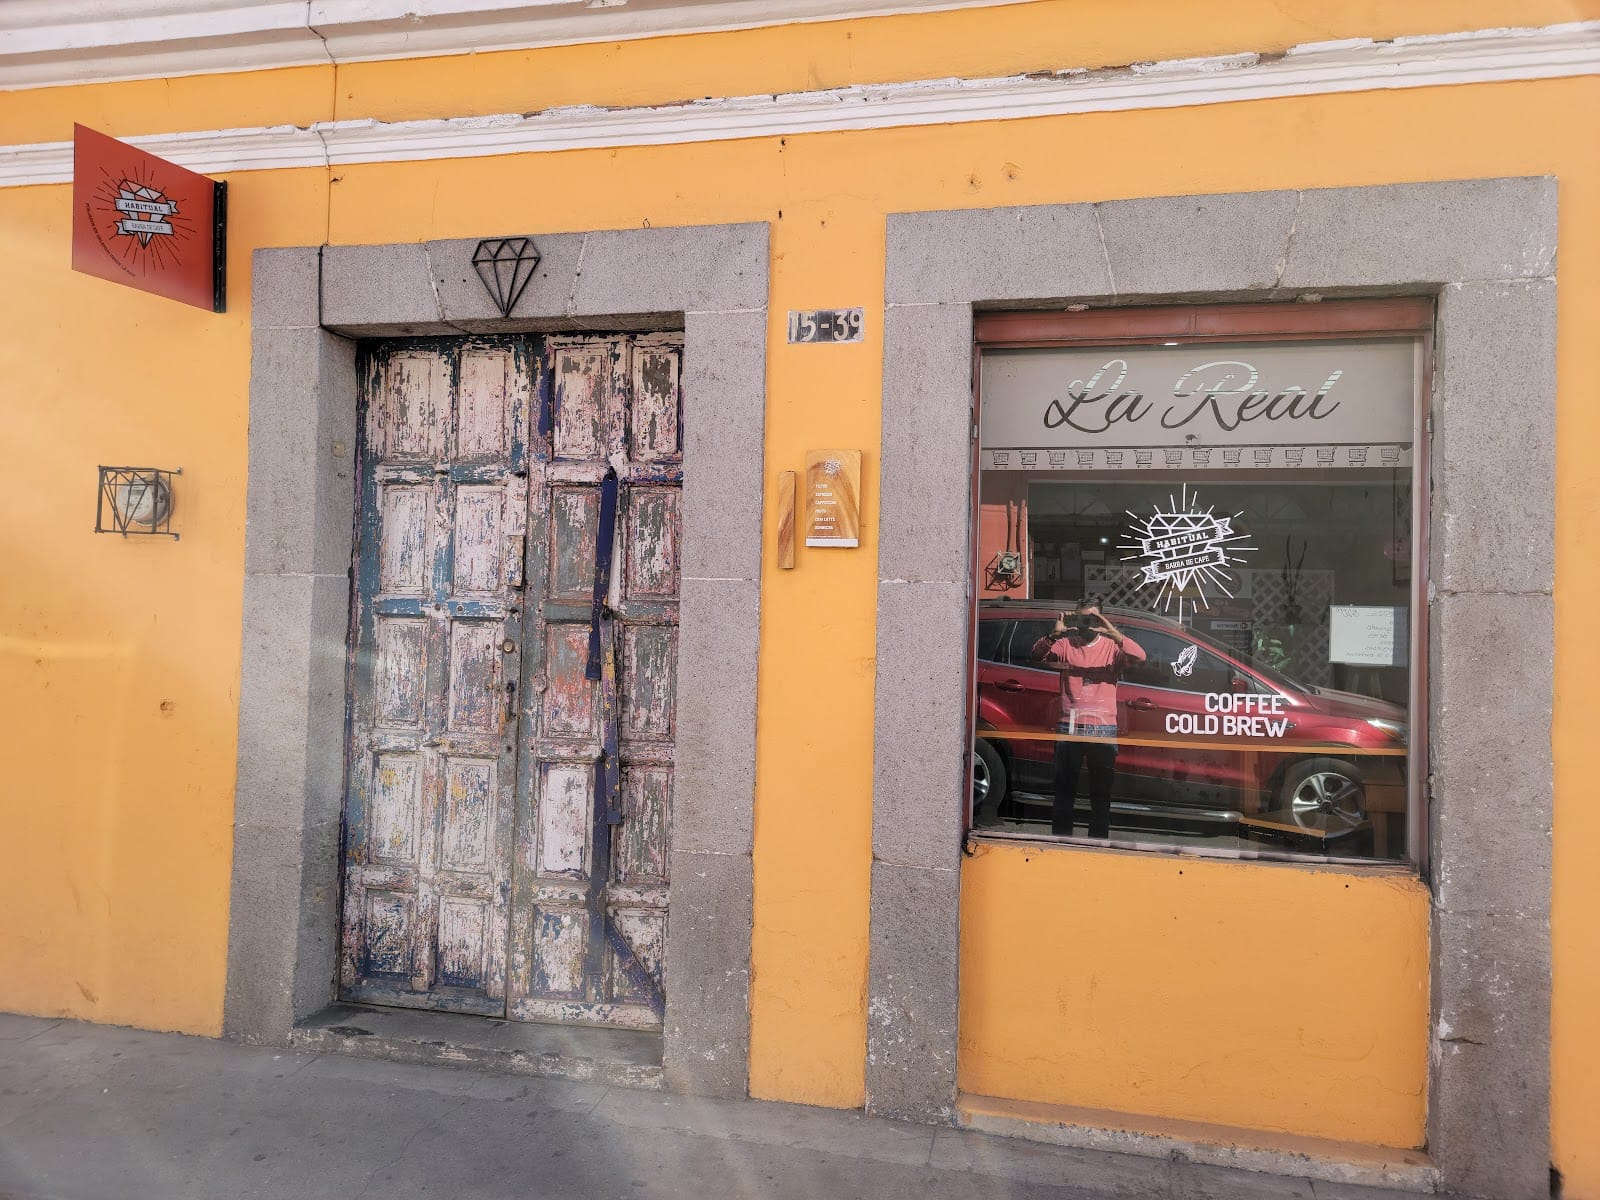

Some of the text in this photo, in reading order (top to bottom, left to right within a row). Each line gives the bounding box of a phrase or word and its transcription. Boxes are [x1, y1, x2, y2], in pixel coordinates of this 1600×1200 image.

[124, 202, 163, 212] HABITUAL
[789, 310, 864, 342] 15-39
[1043, 358, 1342, 434] La Real
[1156, 532, 1209, 548] HABITUAL
[1204, 692, 1285, 715] COFFEE
[1165, 714, 1289, 738] COLD BREW
